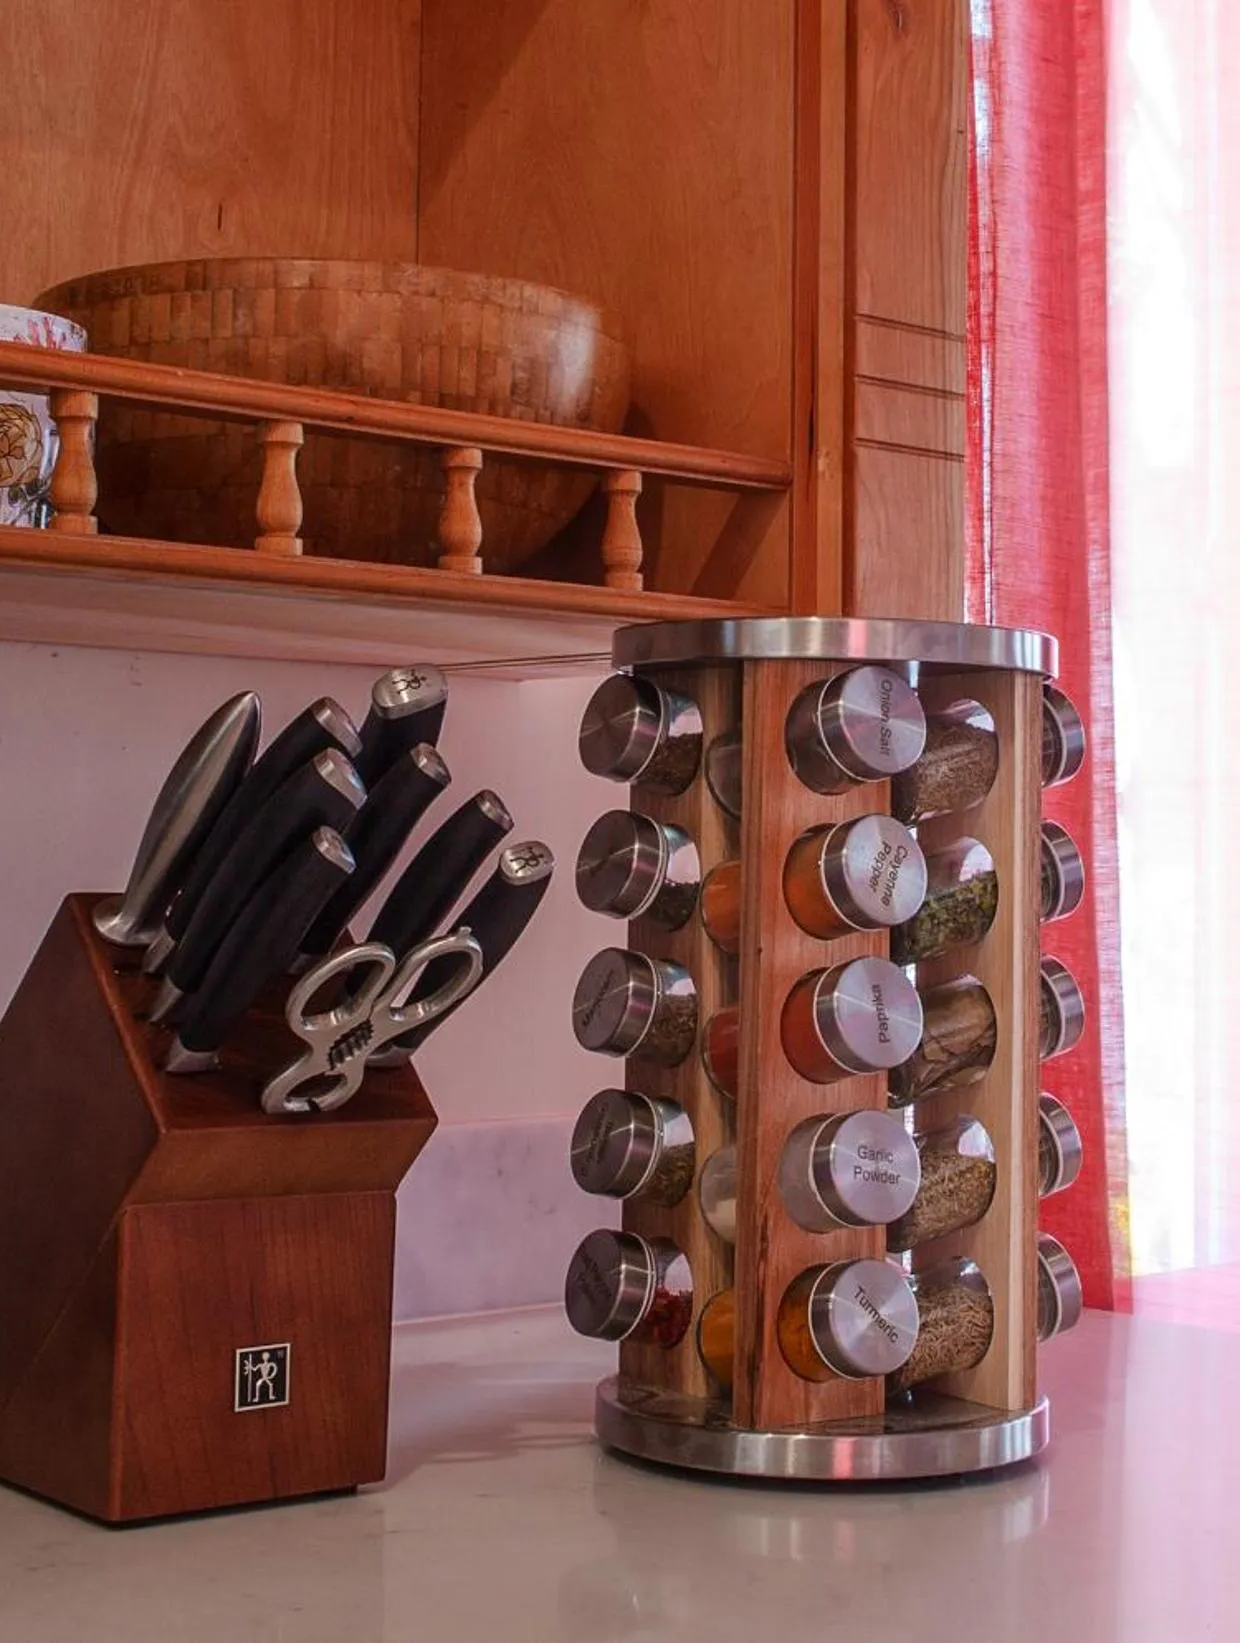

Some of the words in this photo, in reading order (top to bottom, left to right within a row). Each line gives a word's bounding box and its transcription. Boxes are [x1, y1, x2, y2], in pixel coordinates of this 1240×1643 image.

[878, 678, 894, 720] Onion
[879, 722, 892, 757] Salt
[868, 840, 893, 893] Pepper
[880, 844, 909, 908] Cayenne
[871, 983, 891, 1045] Paprika
[852, 1164, 901, 1186] Powder
[852, 1285, 900, 1344] Turmeric
